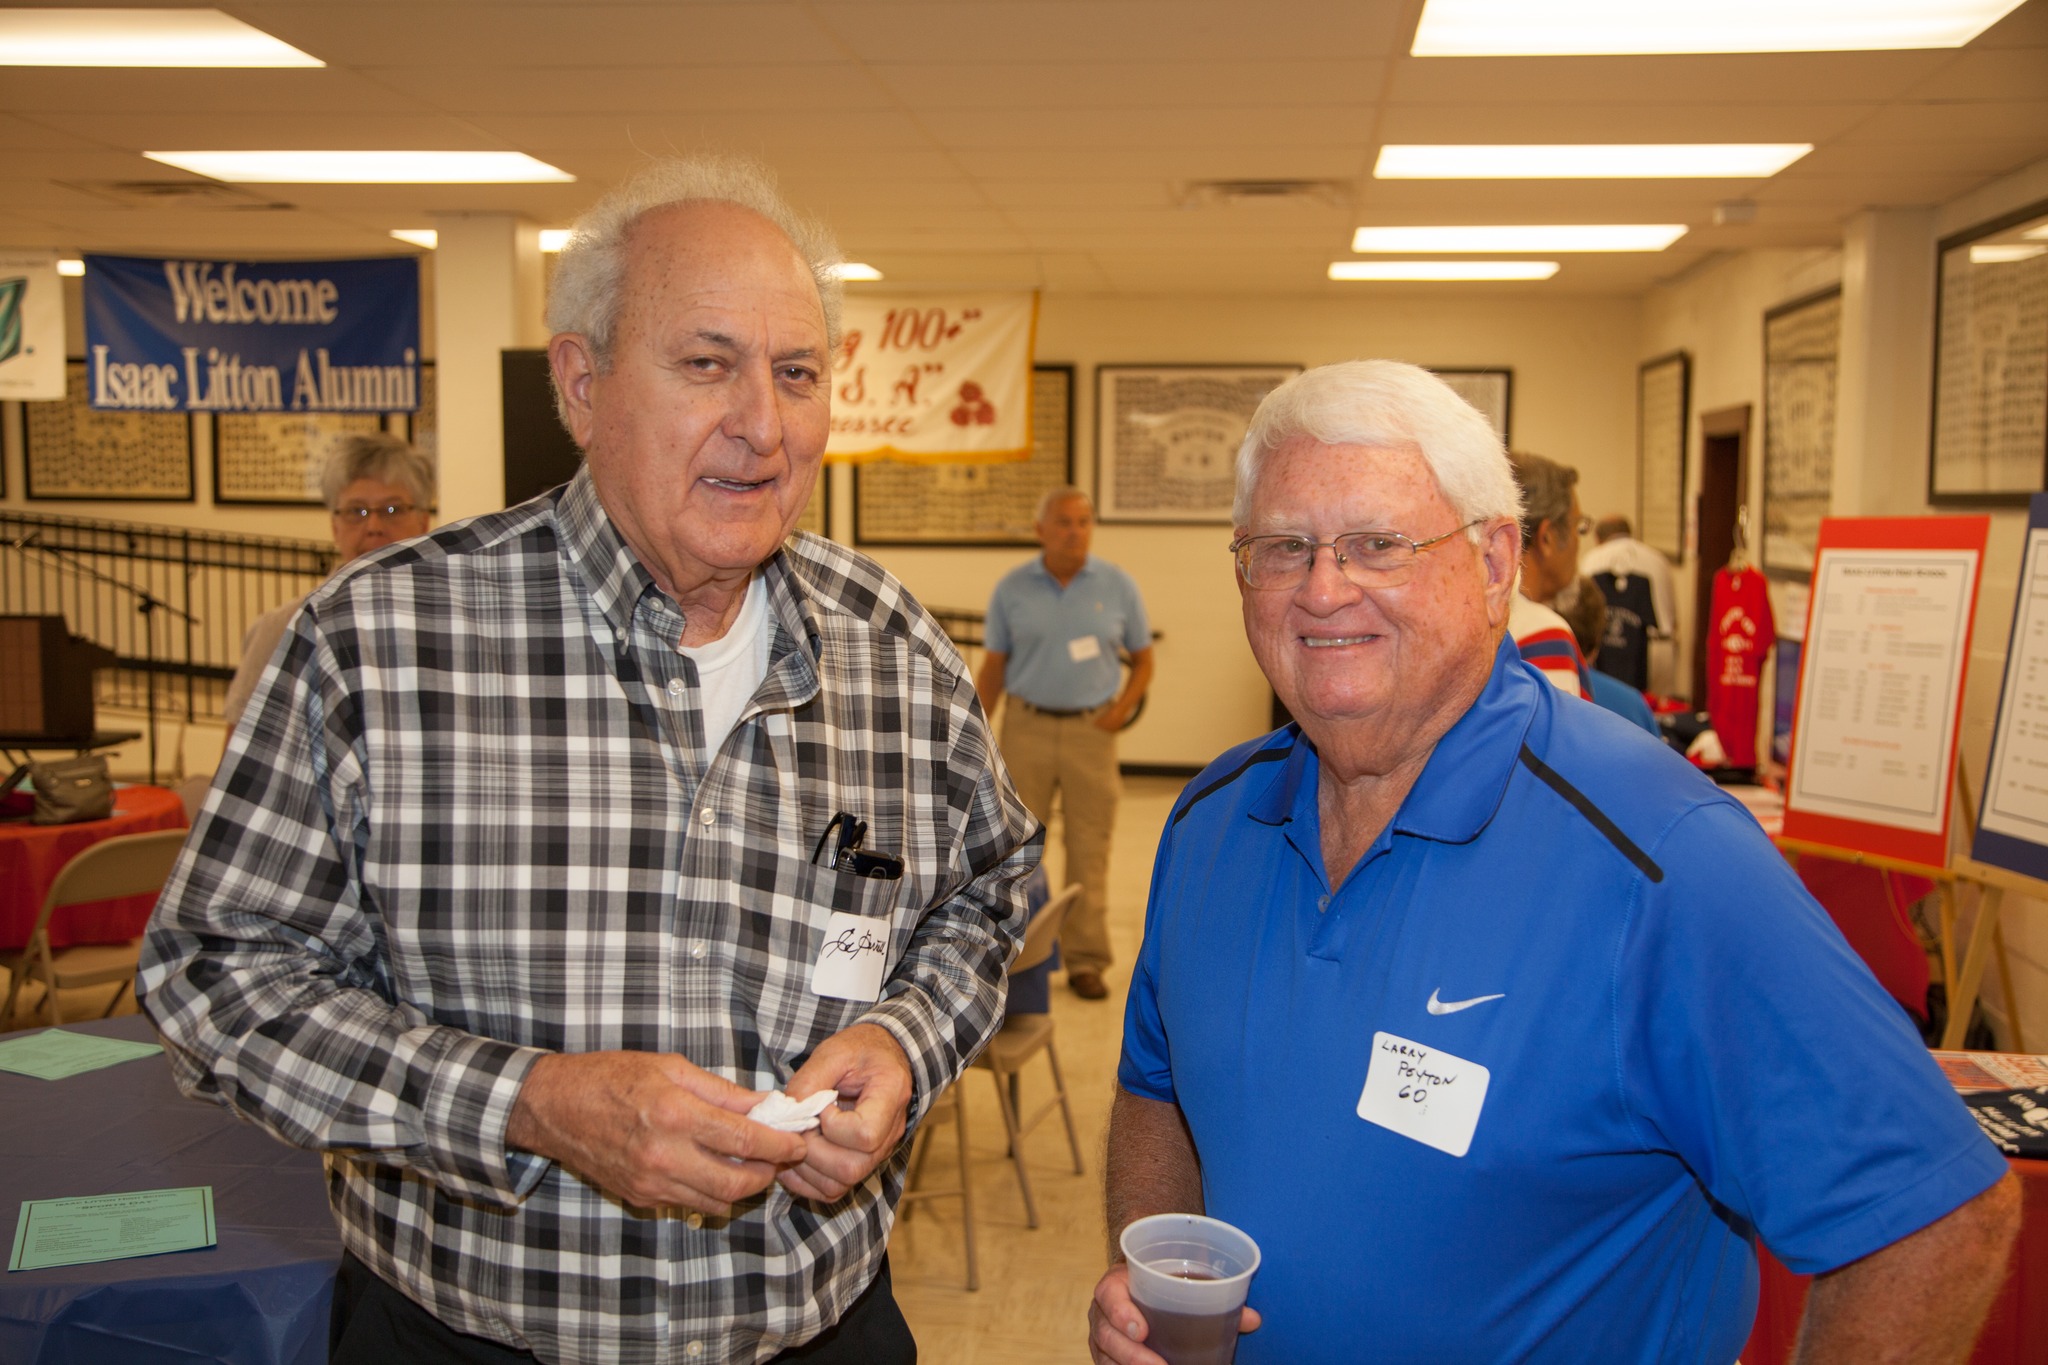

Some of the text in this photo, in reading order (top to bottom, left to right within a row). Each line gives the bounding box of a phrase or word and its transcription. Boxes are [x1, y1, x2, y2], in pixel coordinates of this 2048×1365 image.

[164, 261, 338, 324] Welcome
[92, 344, 417, 410] Isaac Litton Alumni
[1381, 1040, 1427, 1063] LARRY
[1397, 1060, 1457, 1085] PEYTON
[1398, 1085, 1427, 1103] 60
